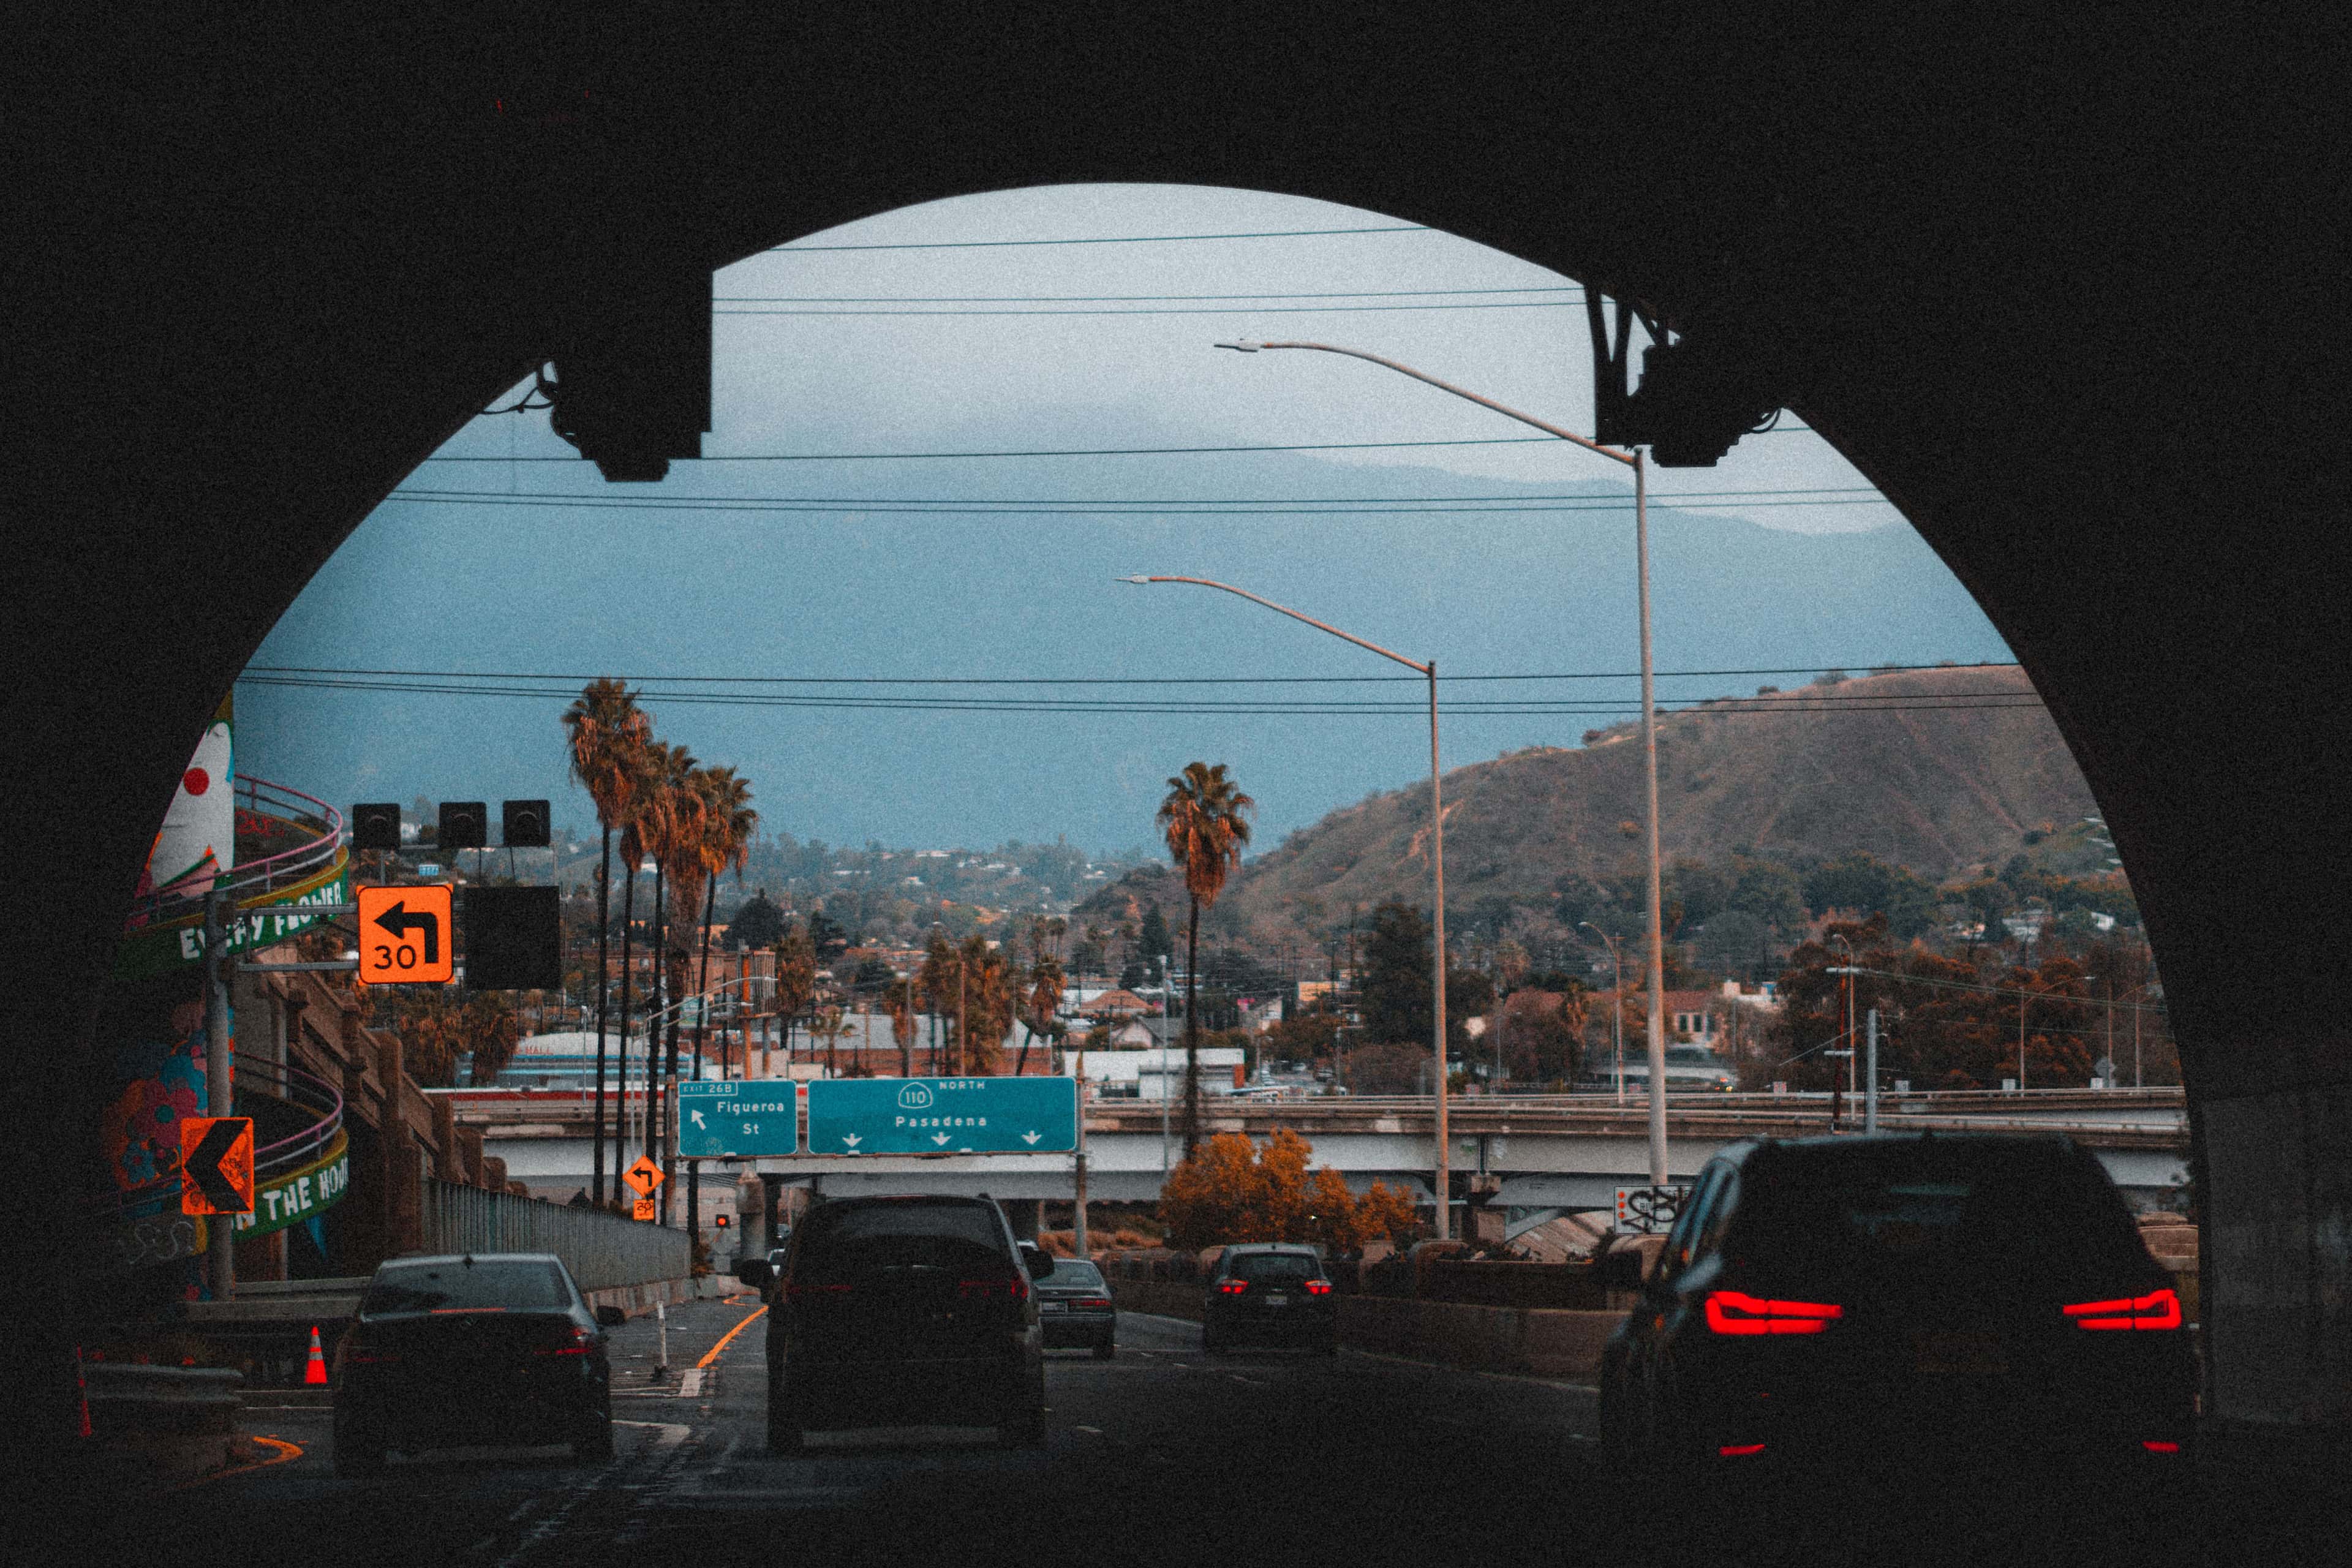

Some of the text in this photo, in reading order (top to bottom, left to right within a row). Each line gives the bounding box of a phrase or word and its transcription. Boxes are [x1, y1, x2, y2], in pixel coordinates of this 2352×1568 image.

[374, 945, 416, 969] 30
[709, 1084, 732, 1093] 26B
[939, 1081, 985, 1090] NORTH
[905, 1091, 926, 1104] 110
[717, 1102, 784, 1115] Figueroa
[895, 1116, 987, 1128] Pasadena
[743, 1123, 759, 1134] St
[263, 1177, 312, 1221] THE
